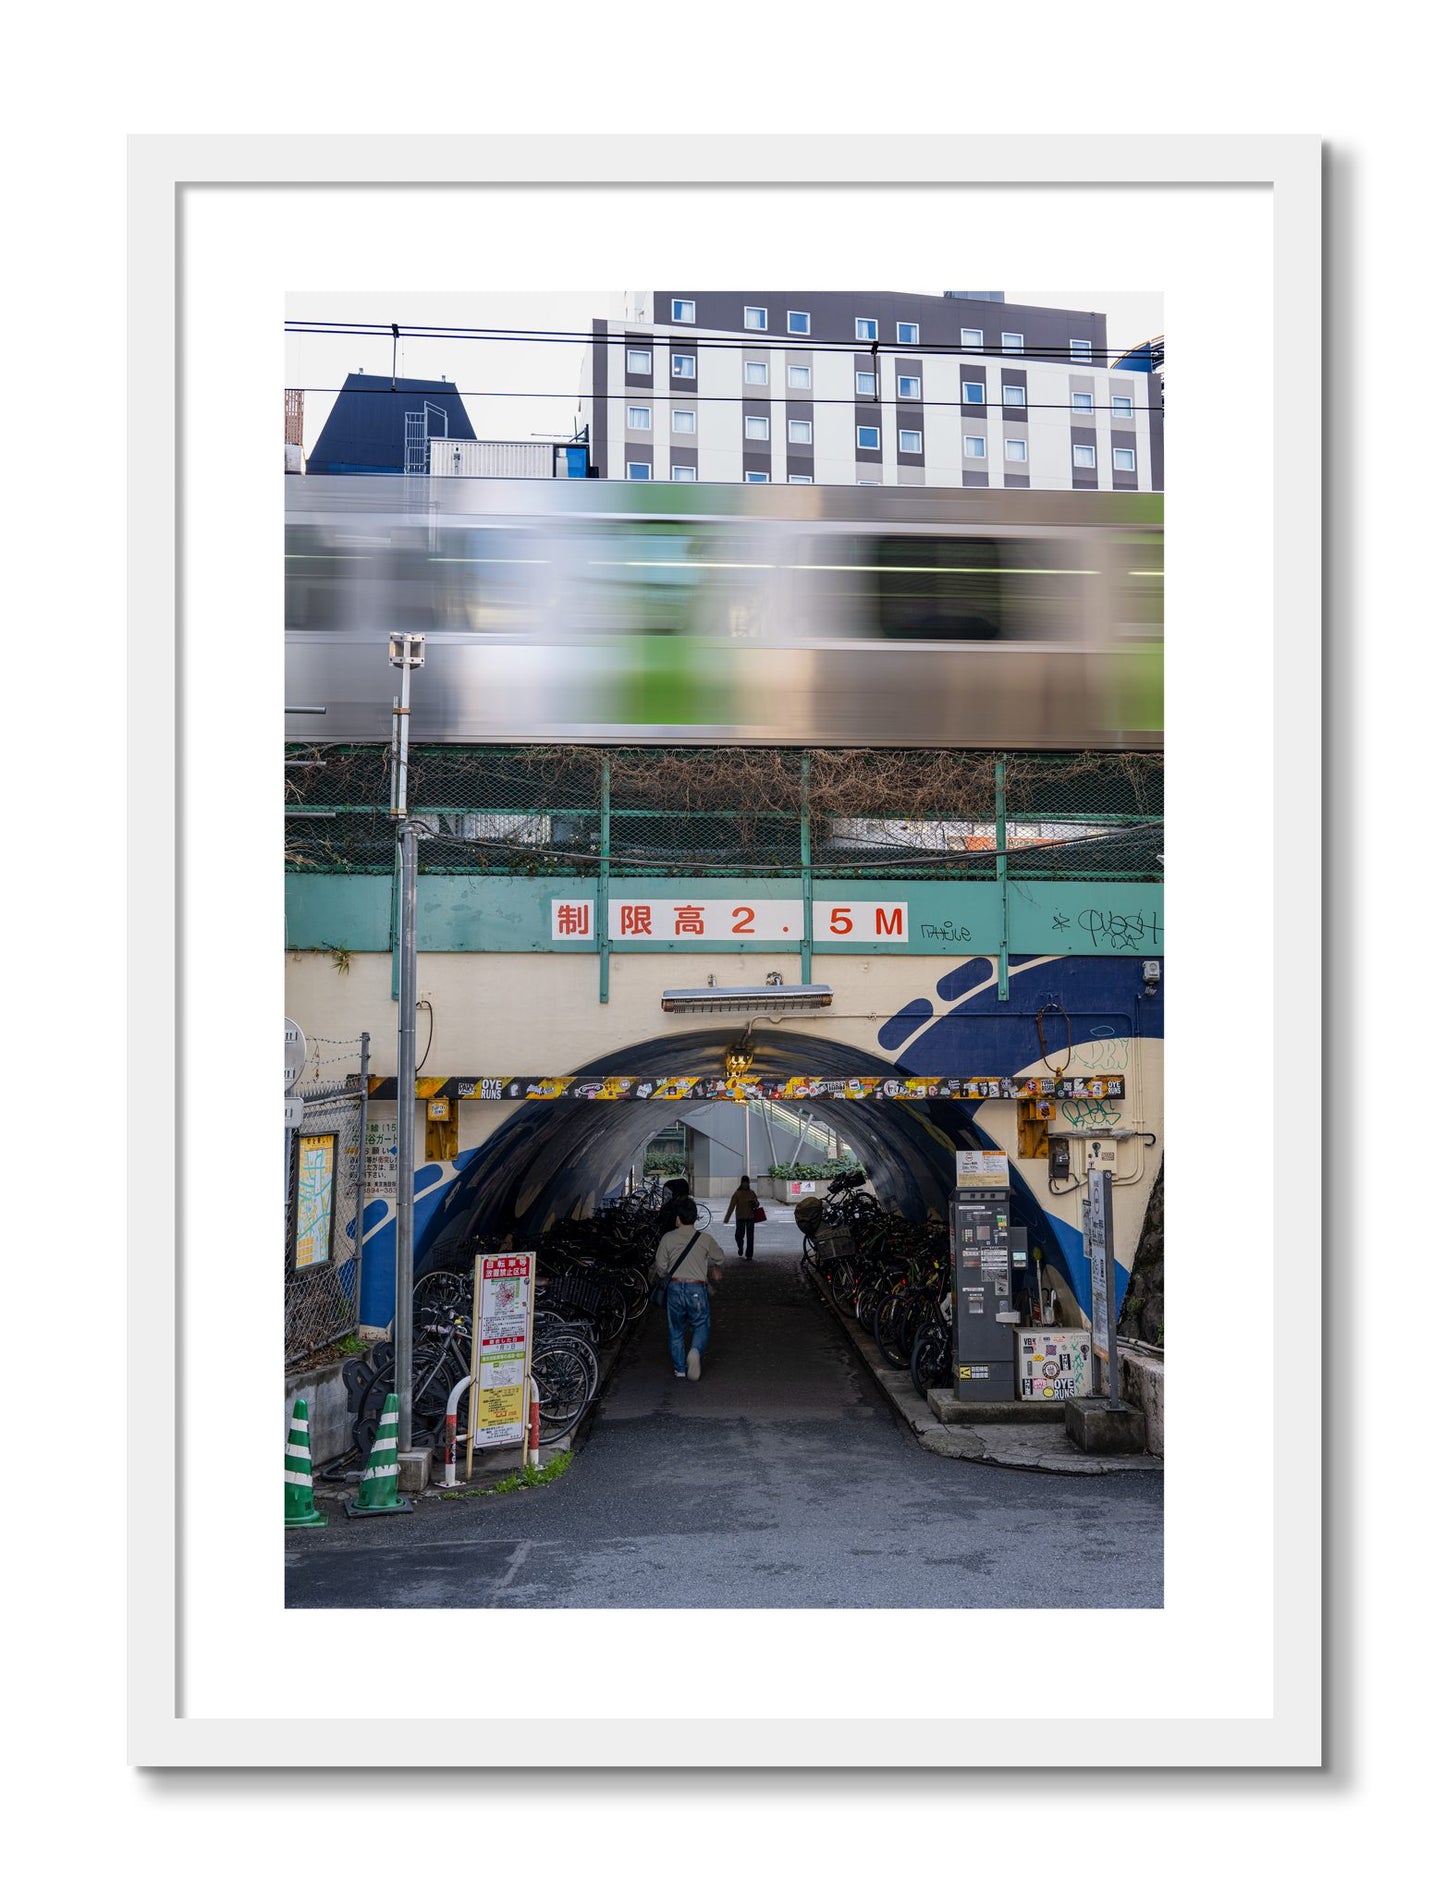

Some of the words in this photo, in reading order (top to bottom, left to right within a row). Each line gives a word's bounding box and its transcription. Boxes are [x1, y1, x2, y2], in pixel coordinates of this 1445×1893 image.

[482, 1079, 503, 1090] OYE
[481, 1089, 502, 1100] RUNS
[1107, 1087, 1121, 1095] RUNS
[1054, 1378, 1075, 1389] OYE
[1054, 1389, 1075, 1400] RUNS
